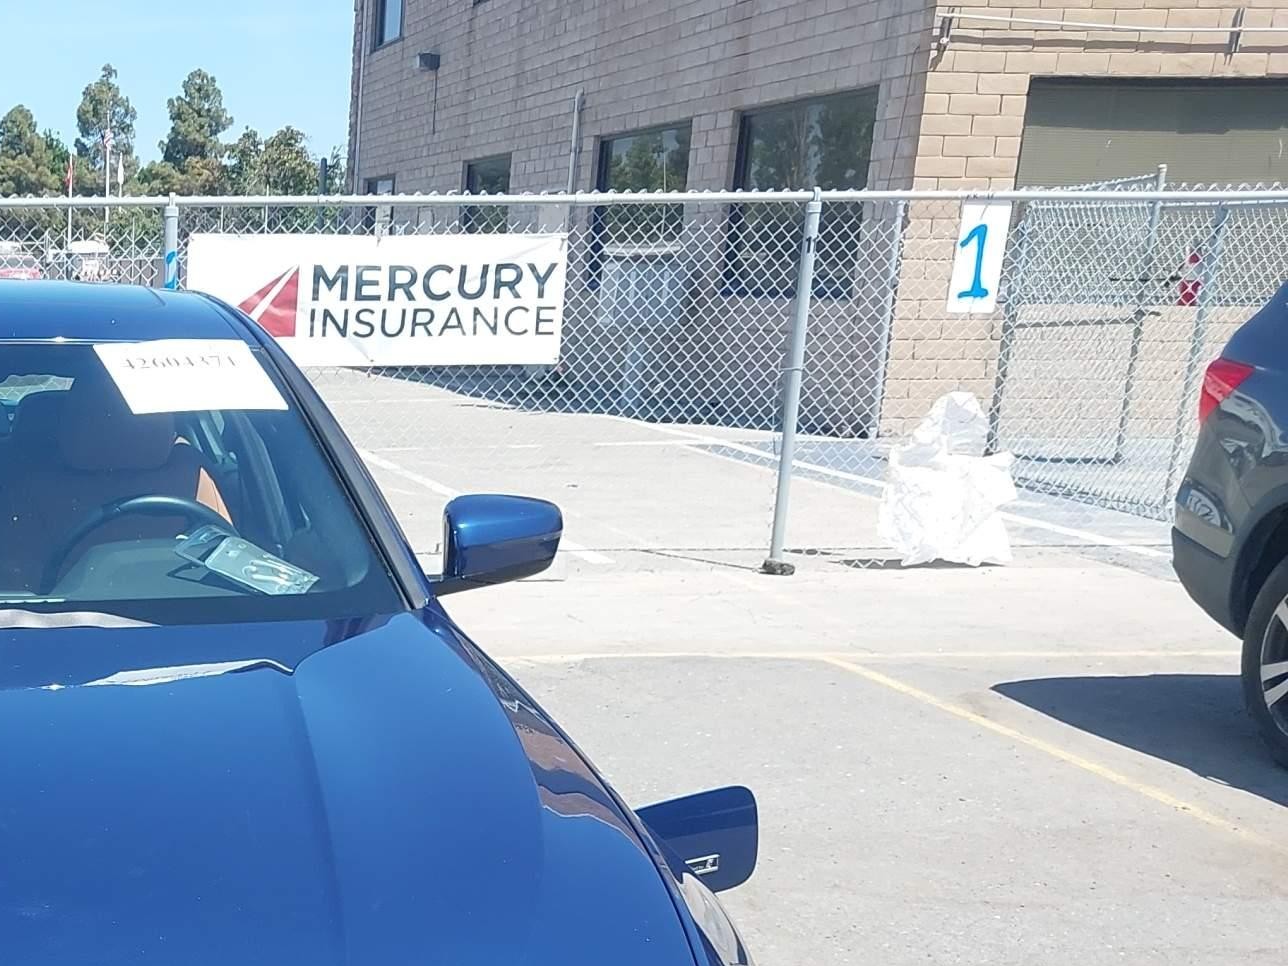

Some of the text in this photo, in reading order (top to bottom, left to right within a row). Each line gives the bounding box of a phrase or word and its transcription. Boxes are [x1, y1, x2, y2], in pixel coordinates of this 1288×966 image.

[957, 223, 989, 299] 1
[311, 262, 558, 301] MERCURY
[309, 306, 557, 338] INSURANCE
